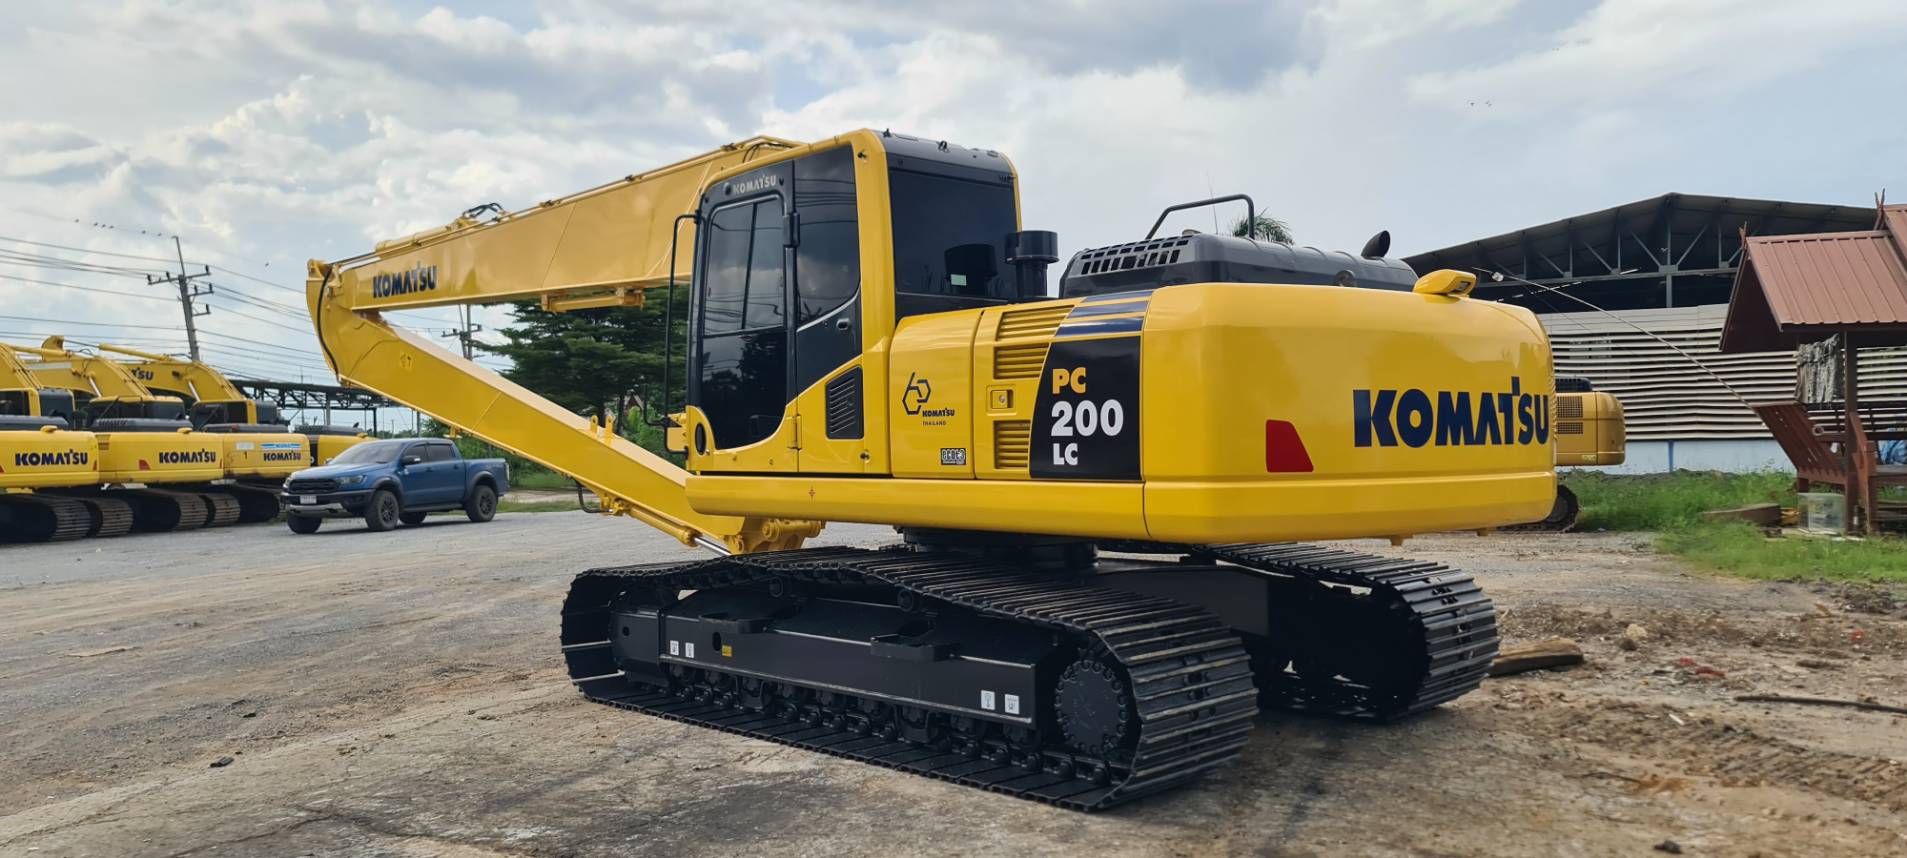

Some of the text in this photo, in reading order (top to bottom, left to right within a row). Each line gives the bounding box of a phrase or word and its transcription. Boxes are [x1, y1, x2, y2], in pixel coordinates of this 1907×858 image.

[734, 174, 776, 194] KOMATSU
[373, 261, 437, 298] KOMATSU
[1052, 367, 1086, 394] PC
[922, 407, 955, 417] KOMATSU
[1051, 399, 1124, 436] 200
[1353, 376, 1549, 448] KOMATSU
[15, 449, 88, 466] KOMATSU
[159, 448, 216, 464] KOMATSU
[263, 450, 302, 461] KOMATSU
[1053, 442, 1078, 465] LC
